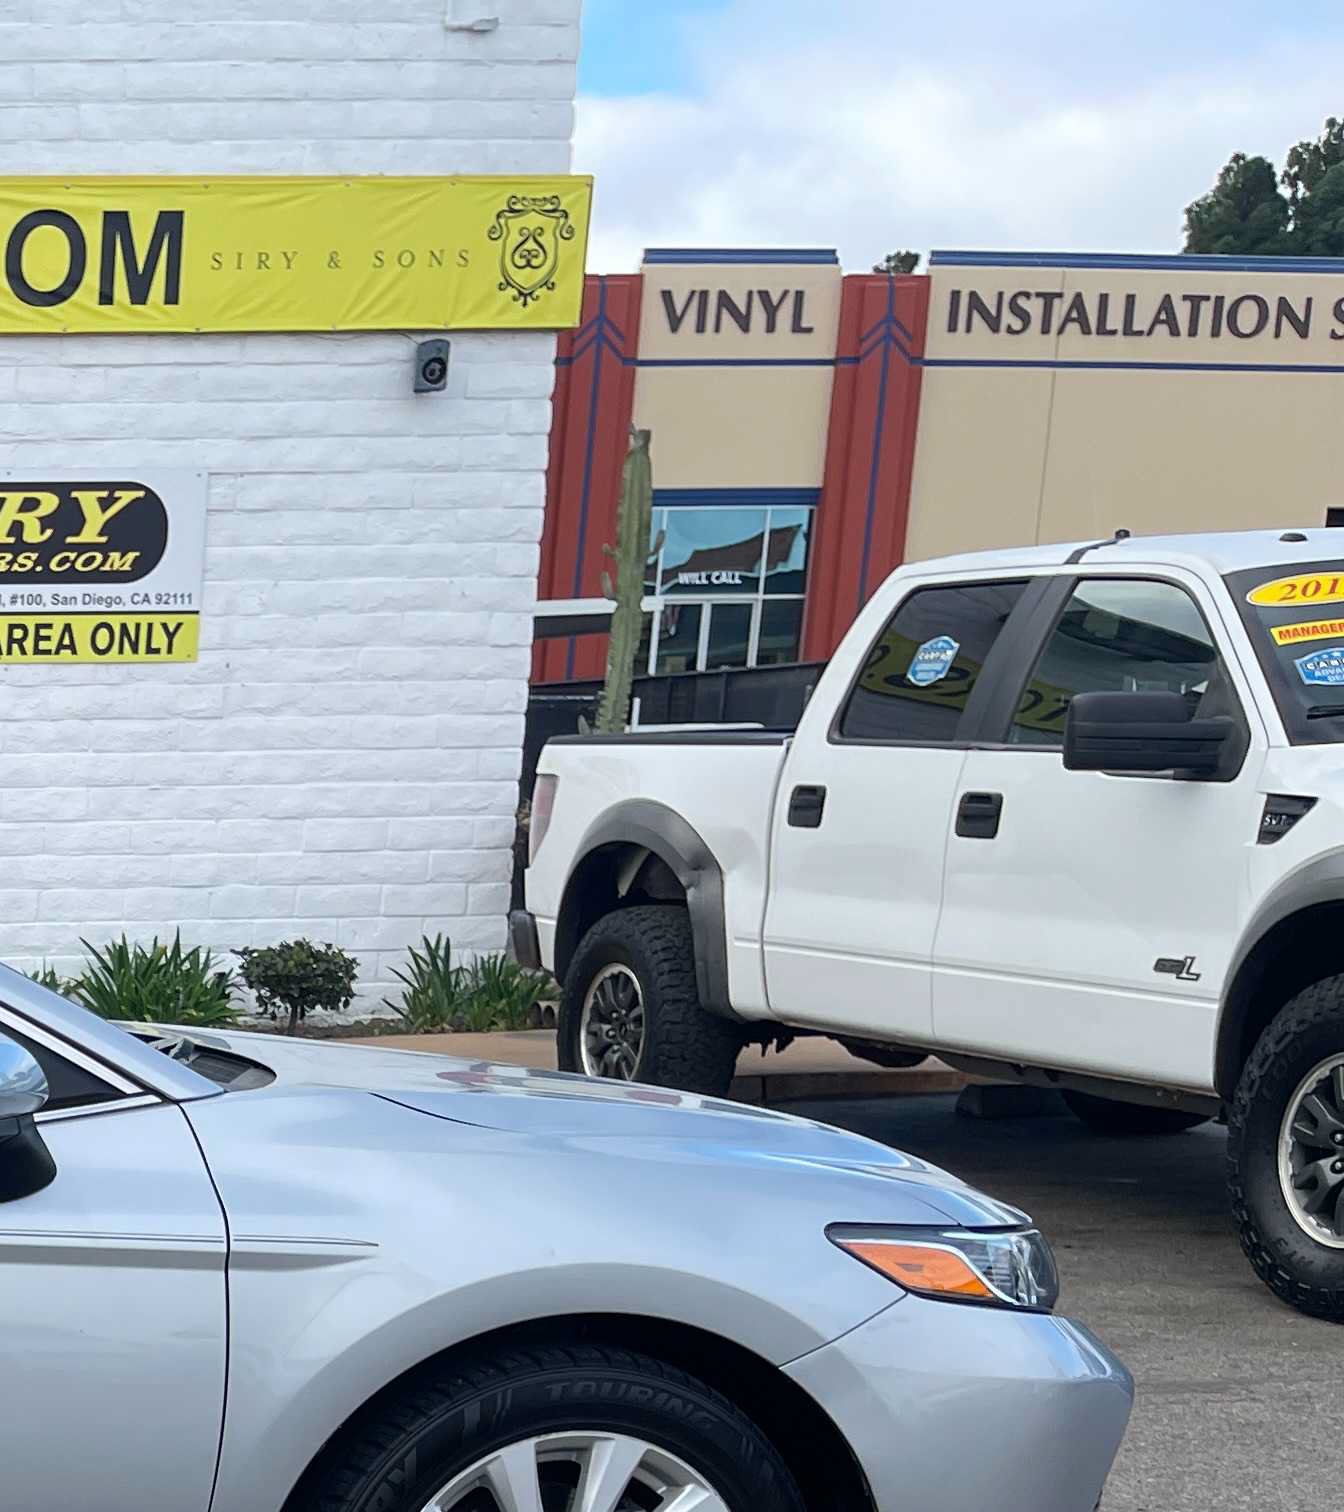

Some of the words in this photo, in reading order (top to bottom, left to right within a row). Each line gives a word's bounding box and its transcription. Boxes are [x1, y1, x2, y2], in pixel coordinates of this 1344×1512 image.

[210, 250, 300, 271] SIRY
[327, 250, 342, 270] &
[373, 248, 470, 269] SONS
[660, 289, 814, 334] VINYL
[946, 289, 1312, 340] INSTALLATION
[678, 570, 708, 585] WILL
[711, 570, 743, 585] CALL
[9, 592, 47, 608] #100,
[50, 592, 78, 606] San
[81, 592, 126, 608] Diego,
[130, 592, 152, 606] CA
[154, 592, 193, 606] 92111
[90, 621, 184, 656] ONLY
